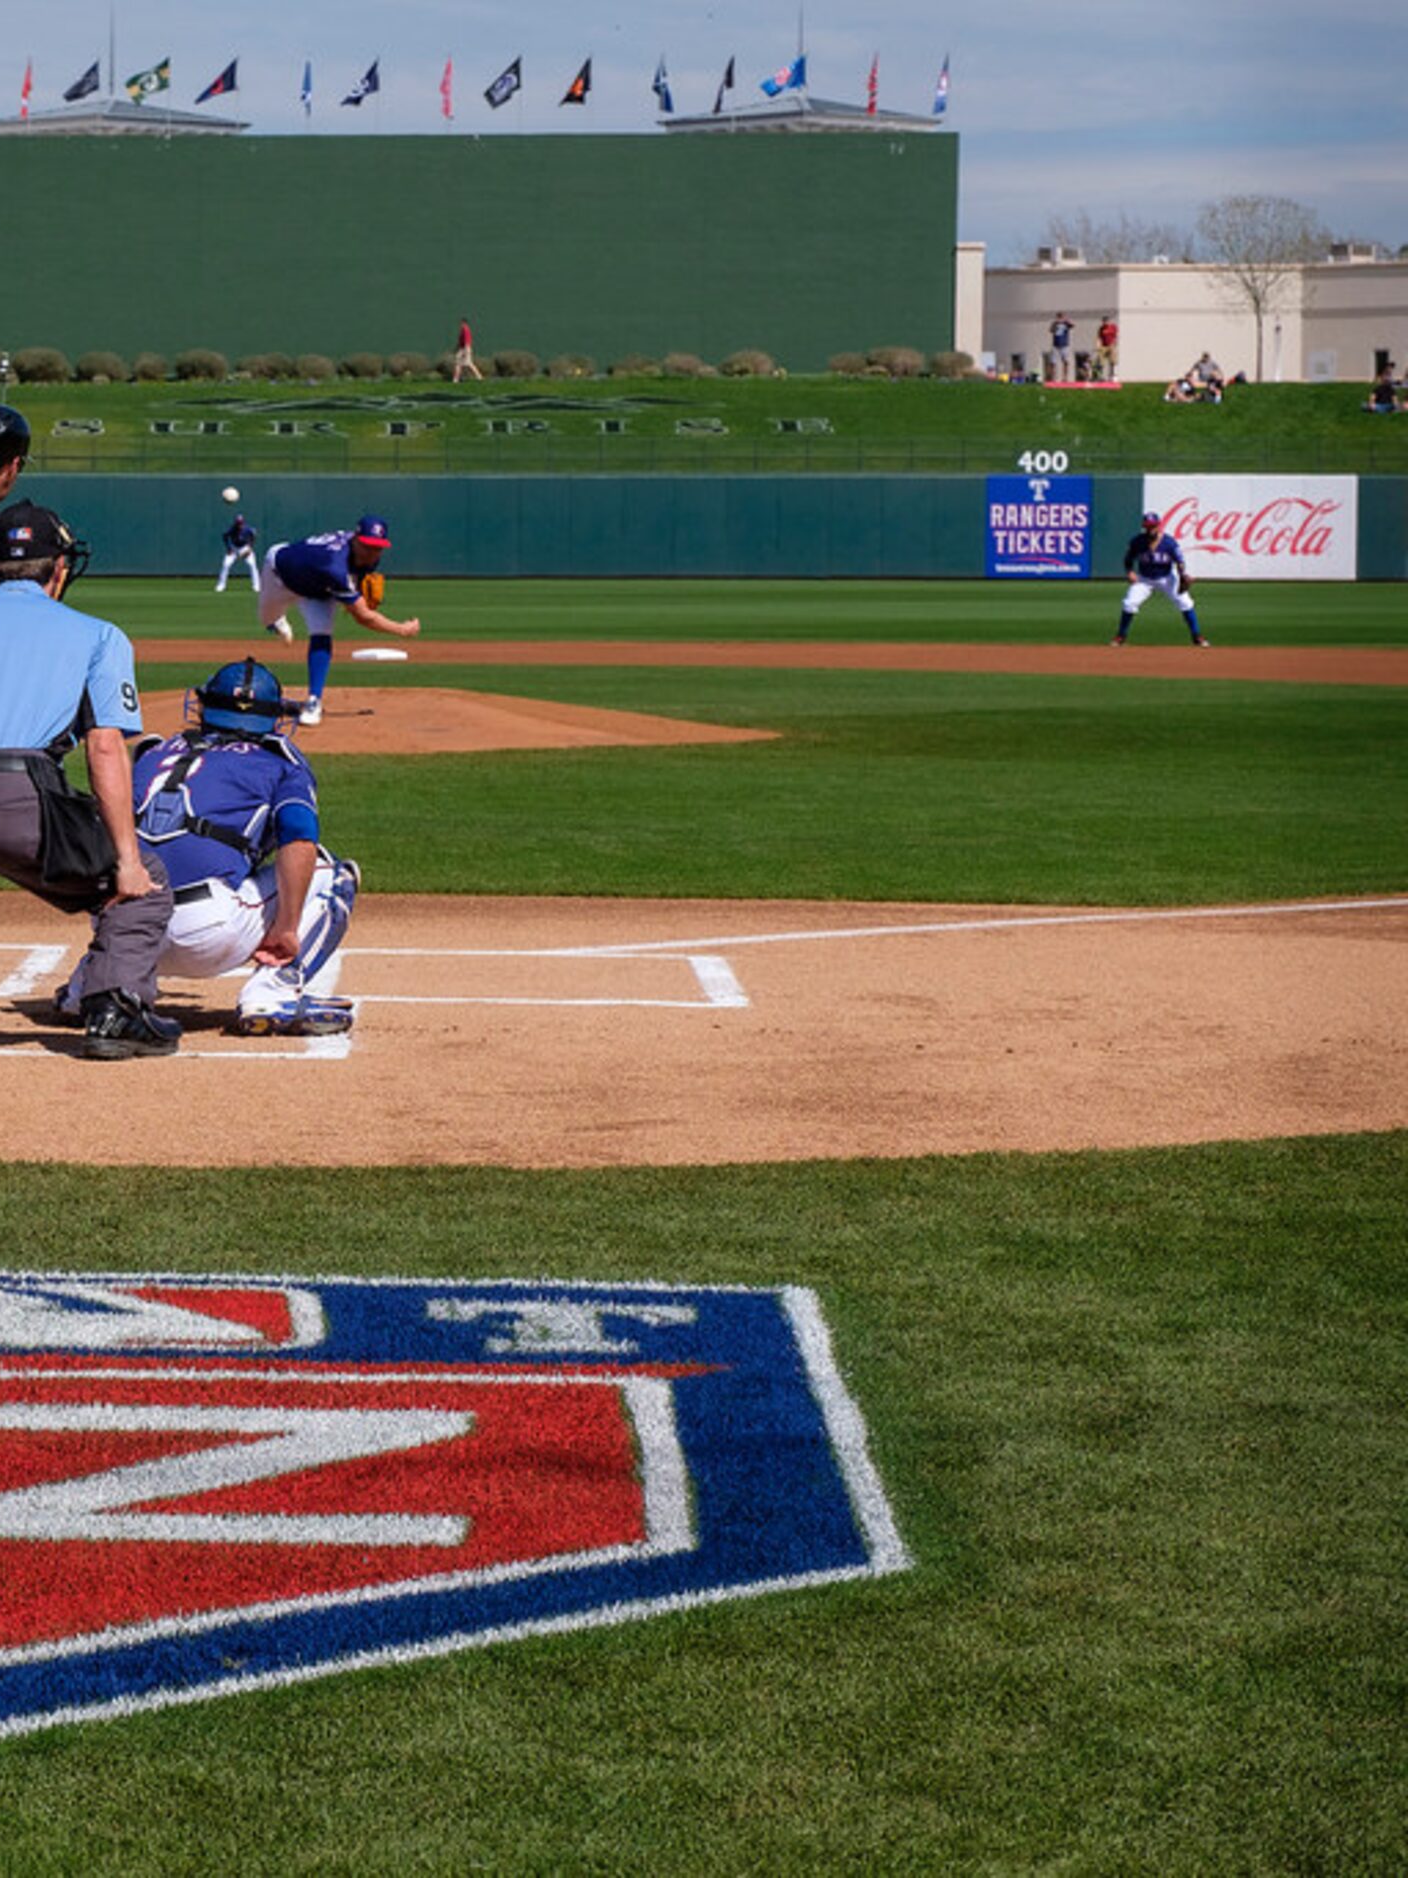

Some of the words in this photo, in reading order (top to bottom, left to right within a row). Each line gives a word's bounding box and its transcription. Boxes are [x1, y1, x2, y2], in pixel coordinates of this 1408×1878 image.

[1017, 450, 1068, 473] 400
[1028, 479, 1051, 502] T
[990, 504, 1088, 528] RANGERS
[1159, 496, 1342, 556] Coca-Cola
[993, 531, 1084, 555] TICKETS
[121, 681, 138, 713] 9
[425, 1299, 696, 1354] T
